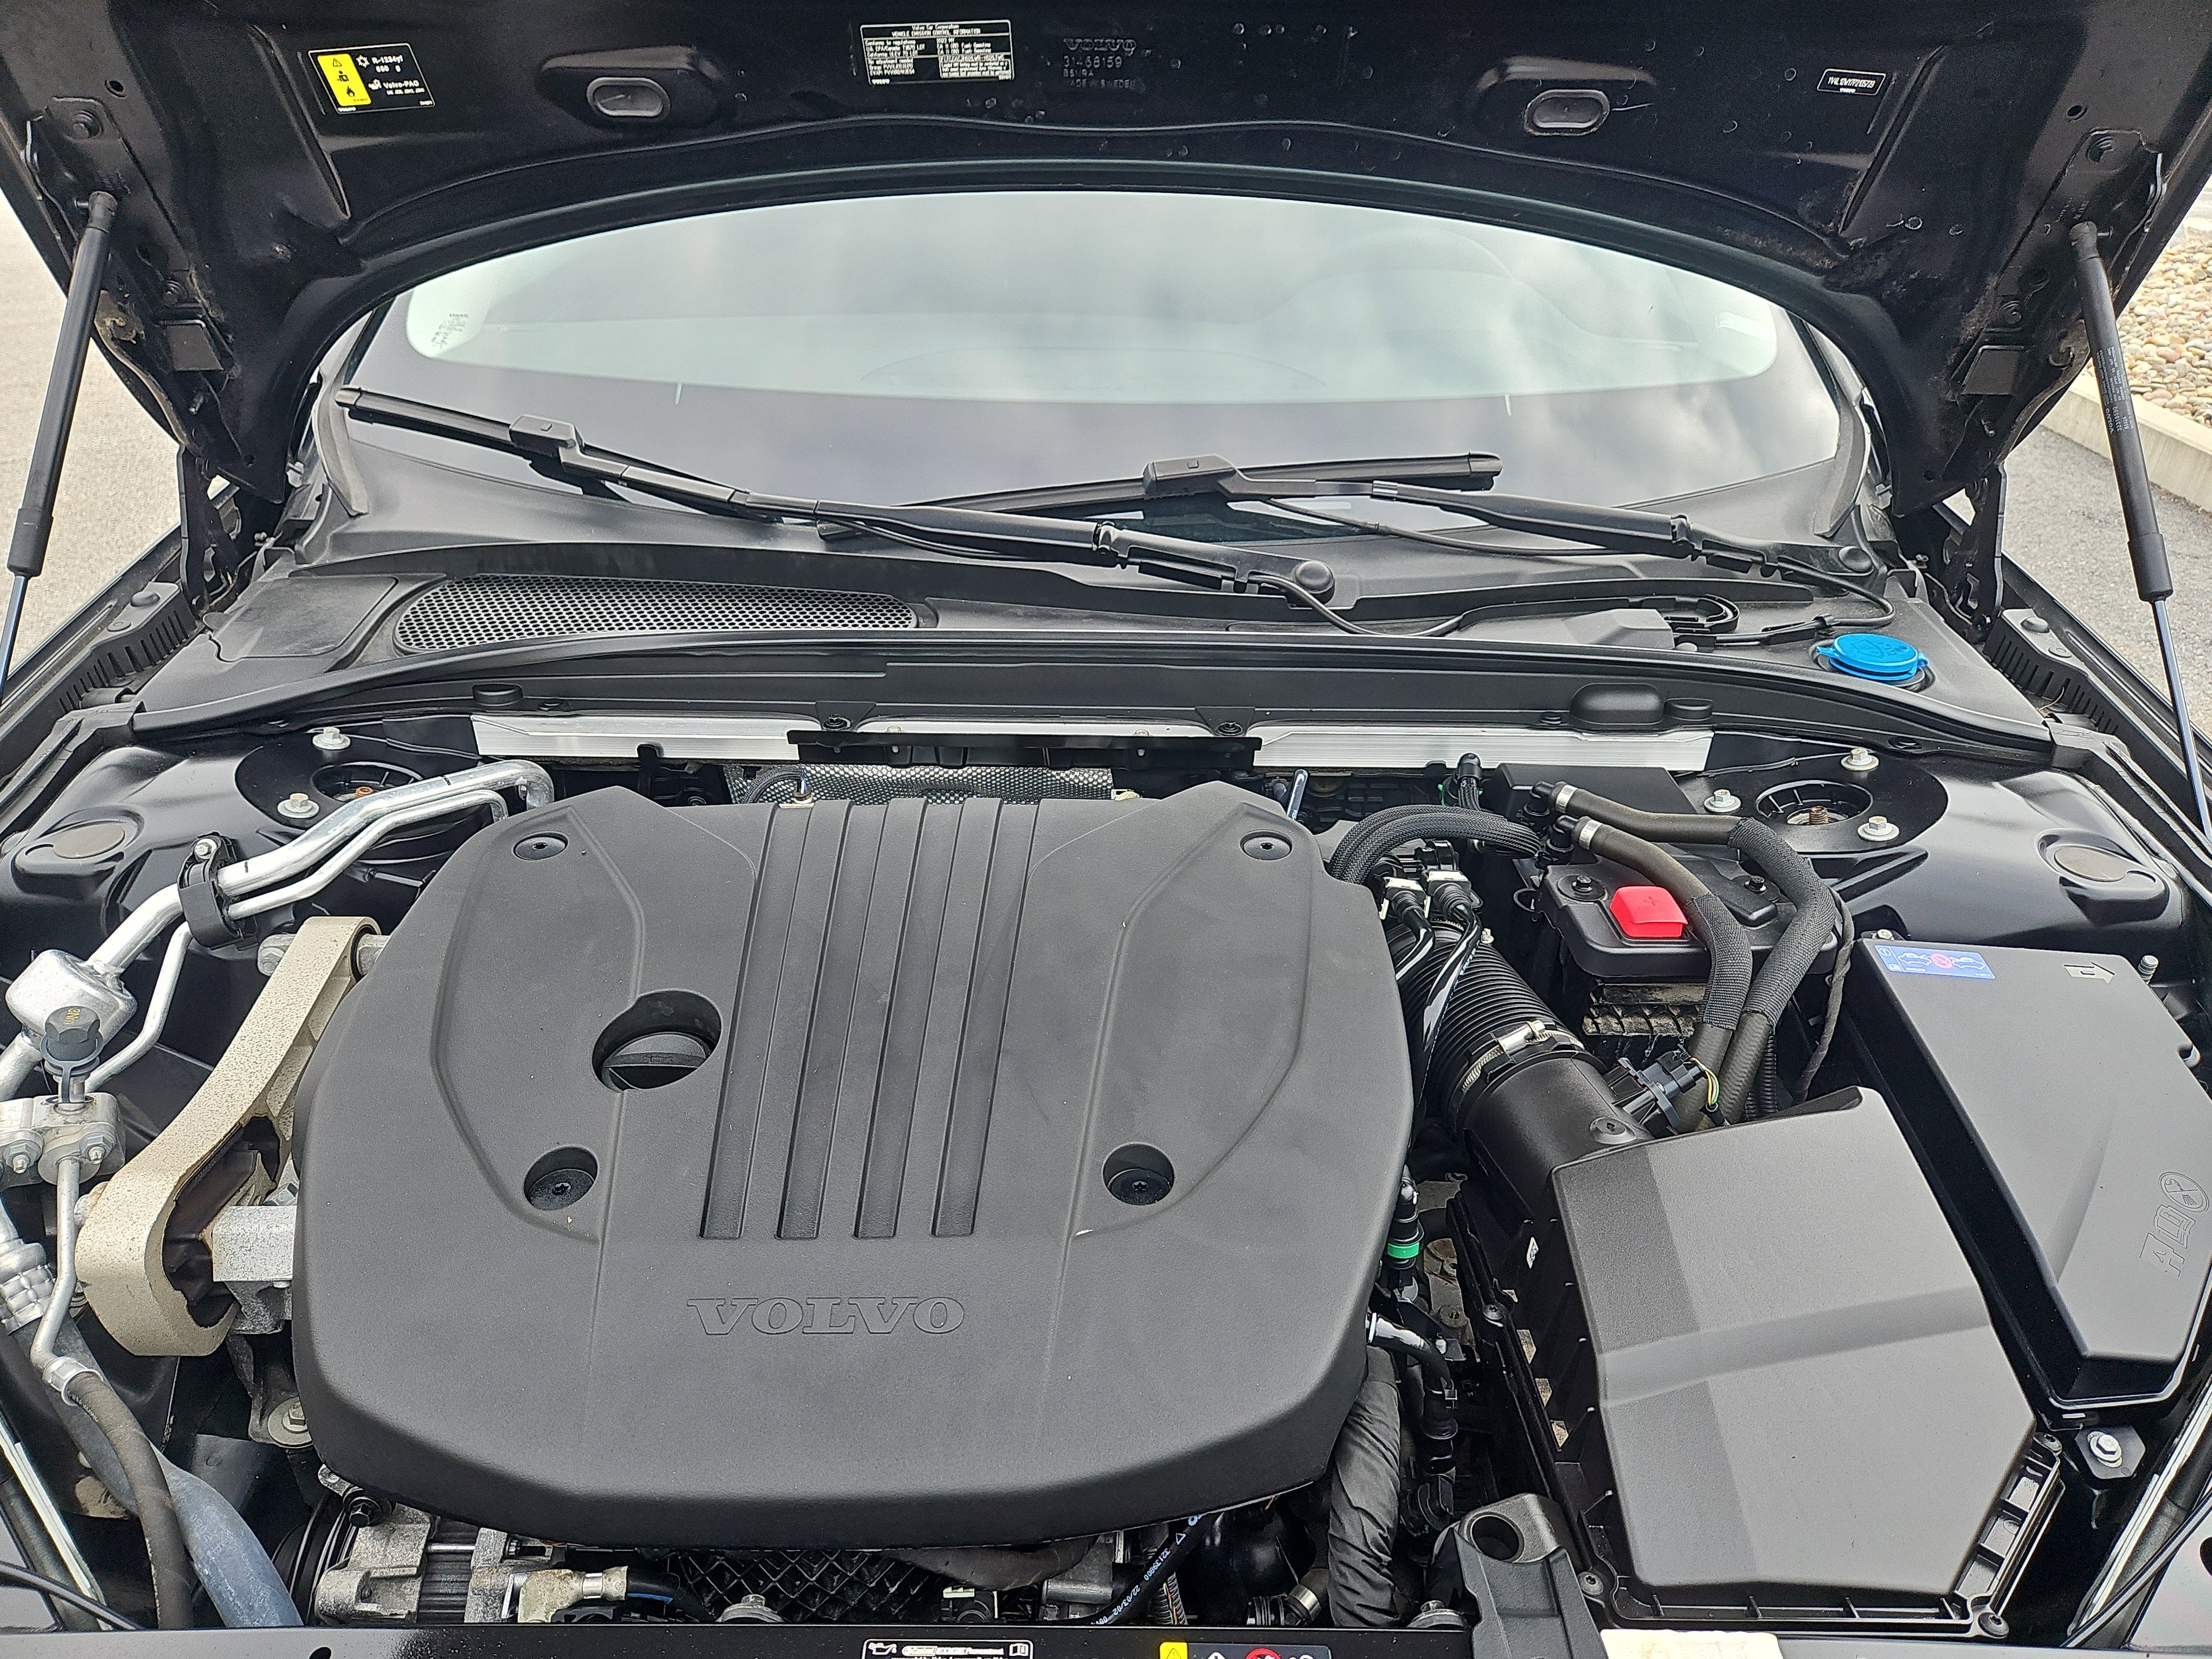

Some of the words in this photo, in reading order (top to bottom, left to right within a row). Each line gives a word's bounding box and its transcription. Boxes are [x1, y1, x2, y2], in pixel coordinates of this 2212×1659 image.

[2105, 408, 2113, 434] VOLVO
[687, 1296, 964, 1335] VOLVO
[1143, 1548, 1171, 1581] 32139800
[1113, 1585, 1140, 1616] 22/03/02
